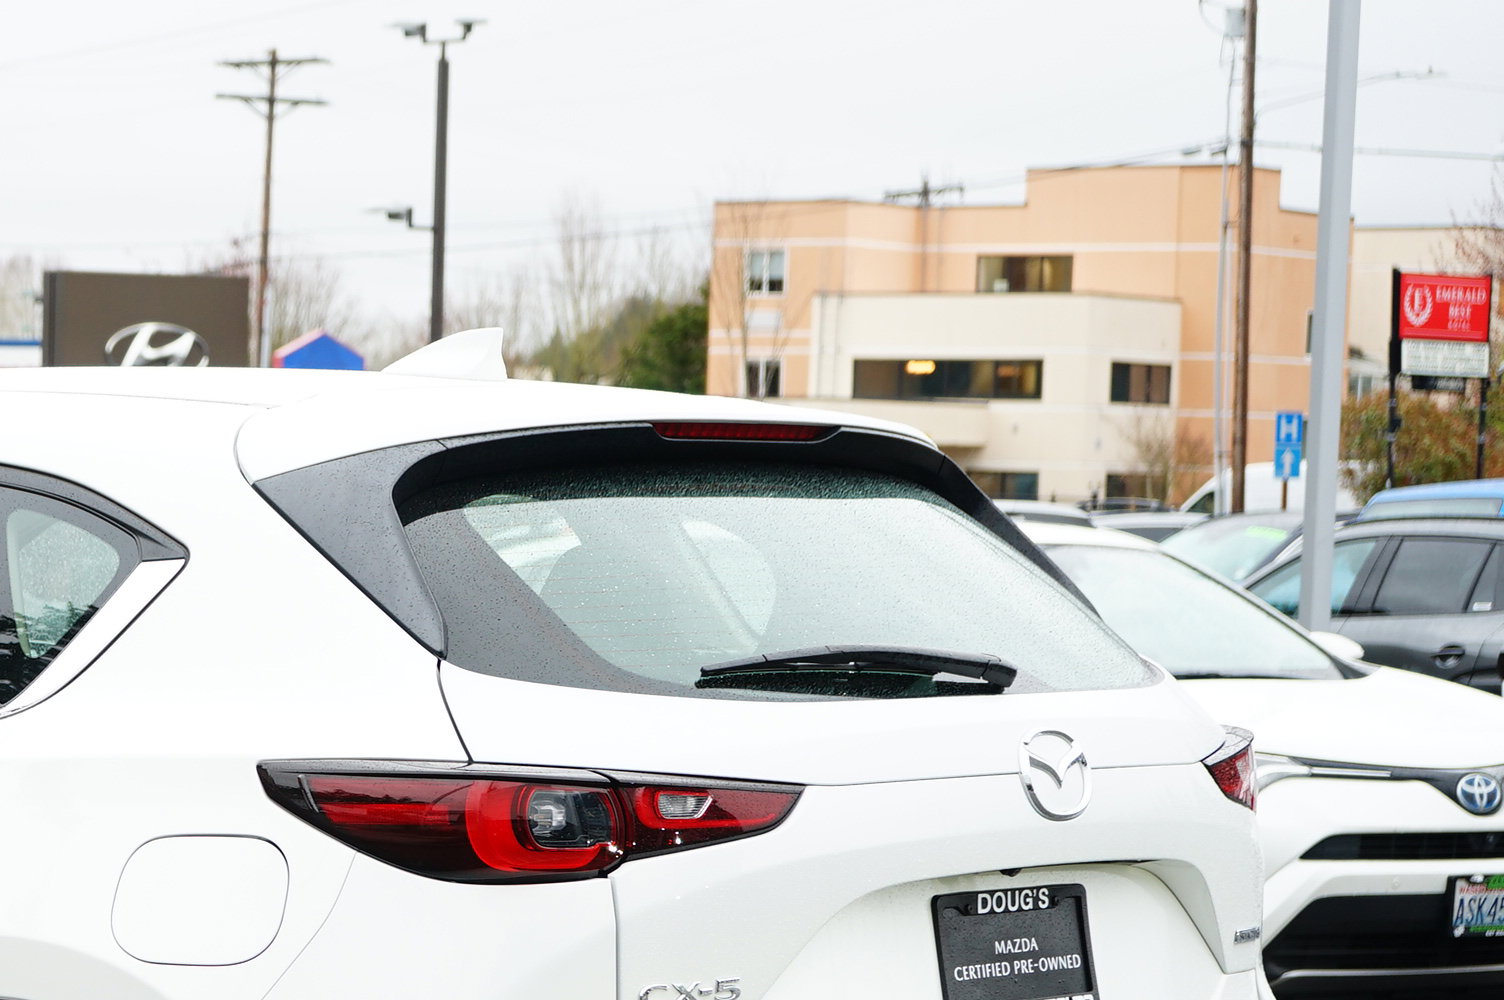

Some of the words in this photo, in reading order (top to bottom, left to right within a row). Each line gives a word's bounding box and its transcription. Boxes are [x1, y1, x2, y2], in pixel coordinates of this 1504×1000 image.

[1436, 285, 1487, 305] EMERALD
[1279, 414, 1299, 440] H
[977, 888, 1049, 914] DOUG'S
[995, 937, 1038, 954] MAZDA
[954, 962, 1010, 981] CERTIFIED
[1014, 954, 1081, 975] PRE-OWNED
